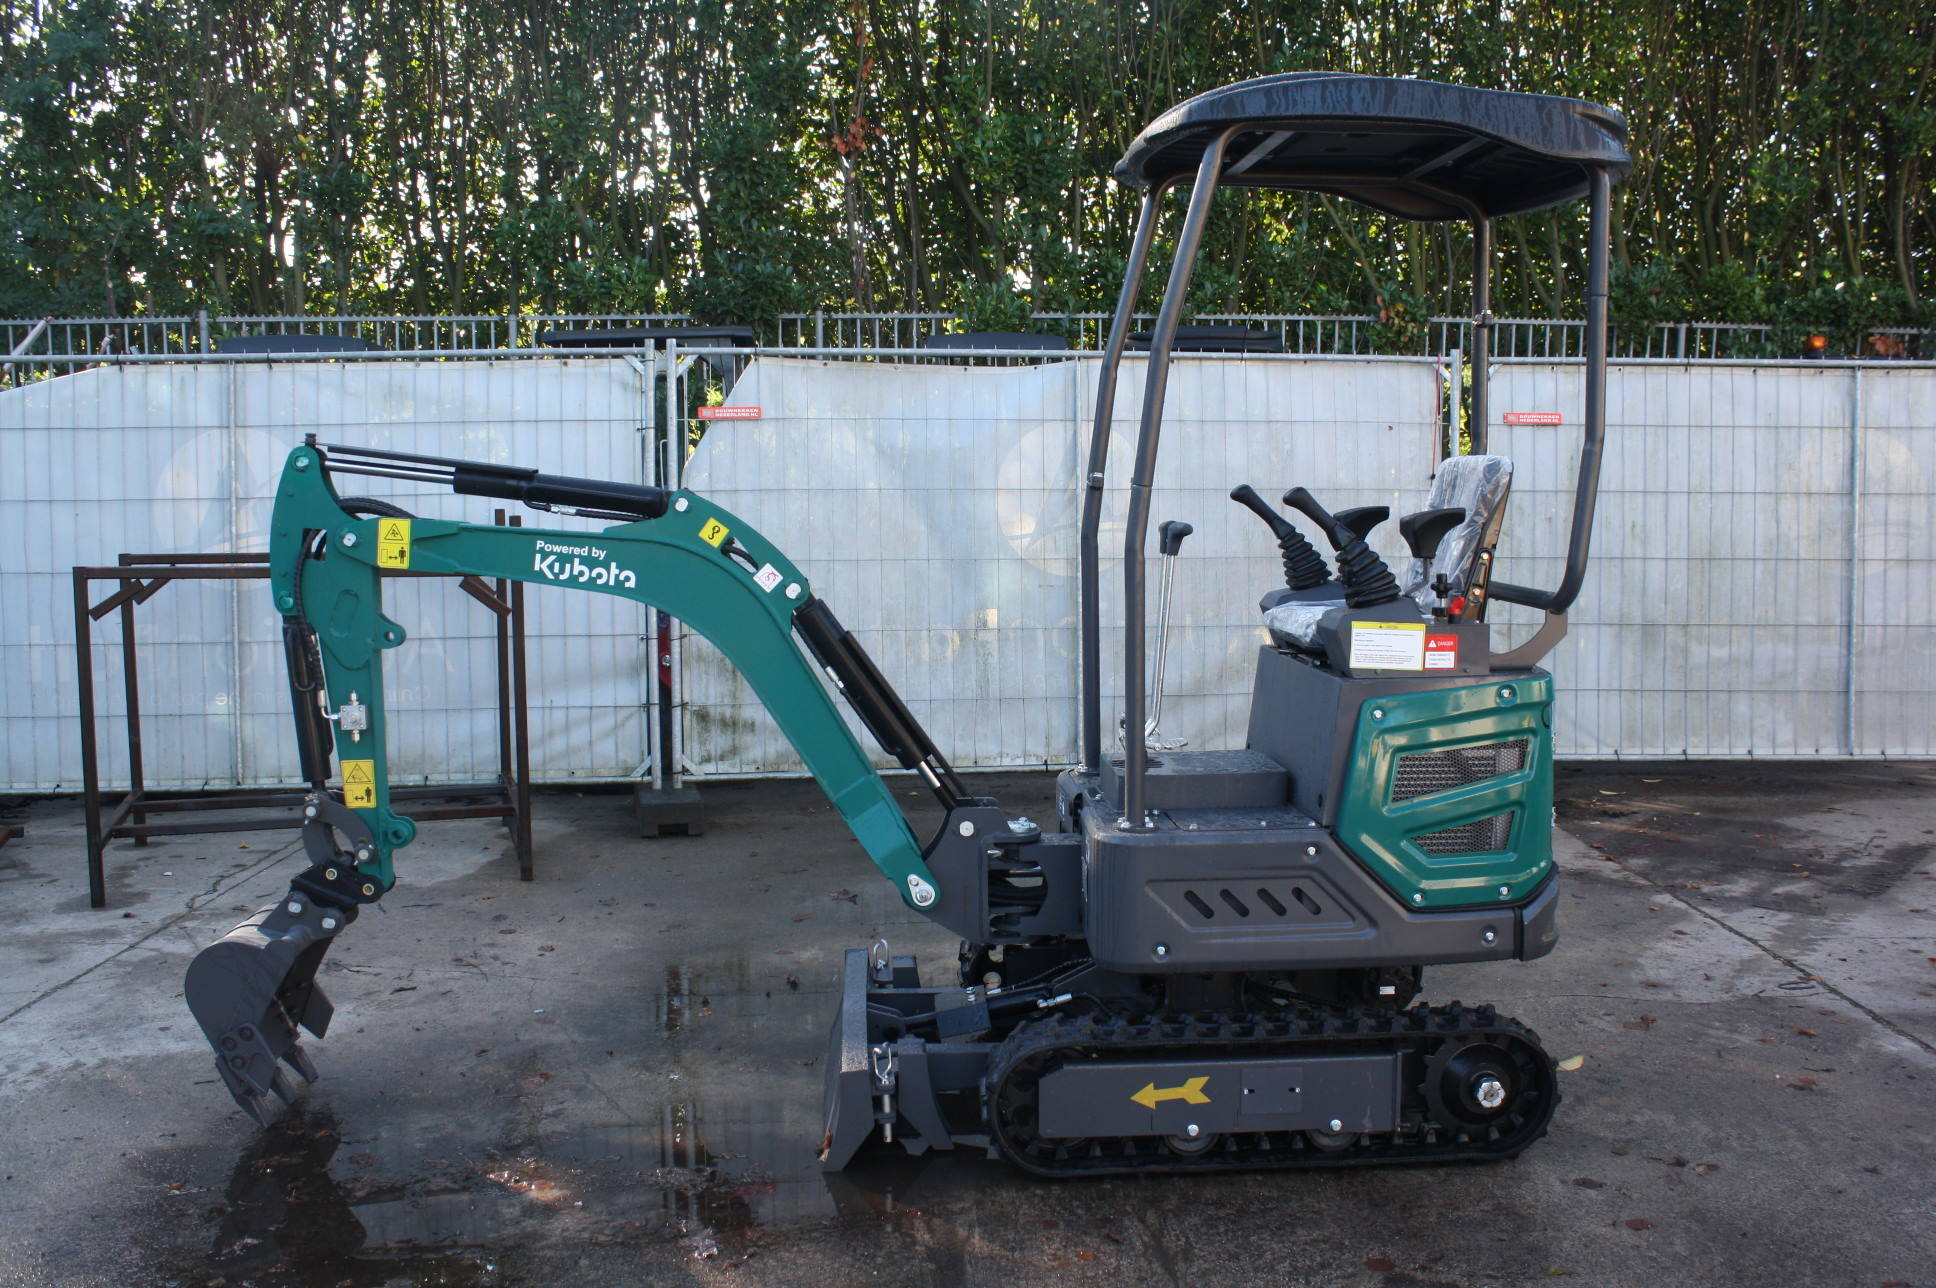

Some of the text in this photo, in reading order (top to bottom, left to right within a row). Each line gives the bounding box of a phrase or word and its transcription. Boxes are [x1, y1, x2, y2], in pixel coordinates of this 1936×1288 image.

[536, 540, 607, 560] Powered by
[534, 553, 636, 588] Kubota
